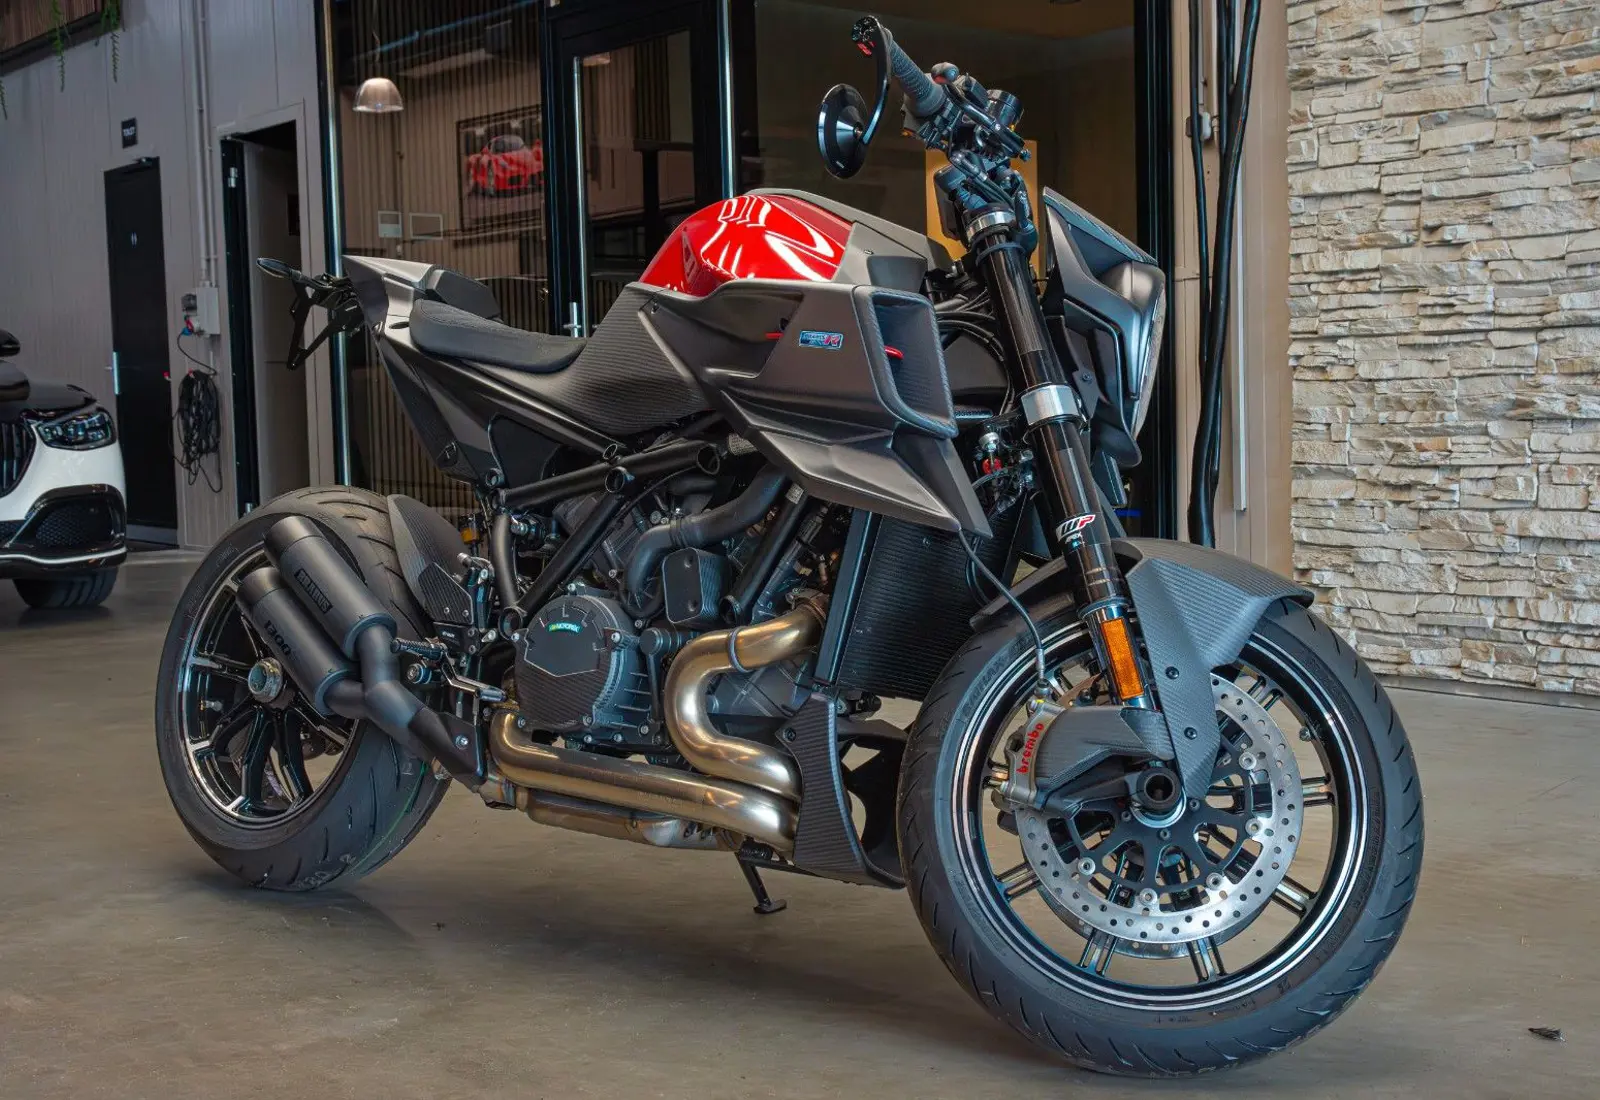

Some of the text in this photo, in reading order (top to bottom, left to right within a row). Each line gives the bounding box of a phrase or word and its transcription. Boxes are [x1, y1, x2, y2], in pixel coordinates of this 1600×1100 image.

[1056, 515, 1096, 541] WP
[297, 570, 331, 612] BRABUS
[1015, 722, 1044, 774] brembo
